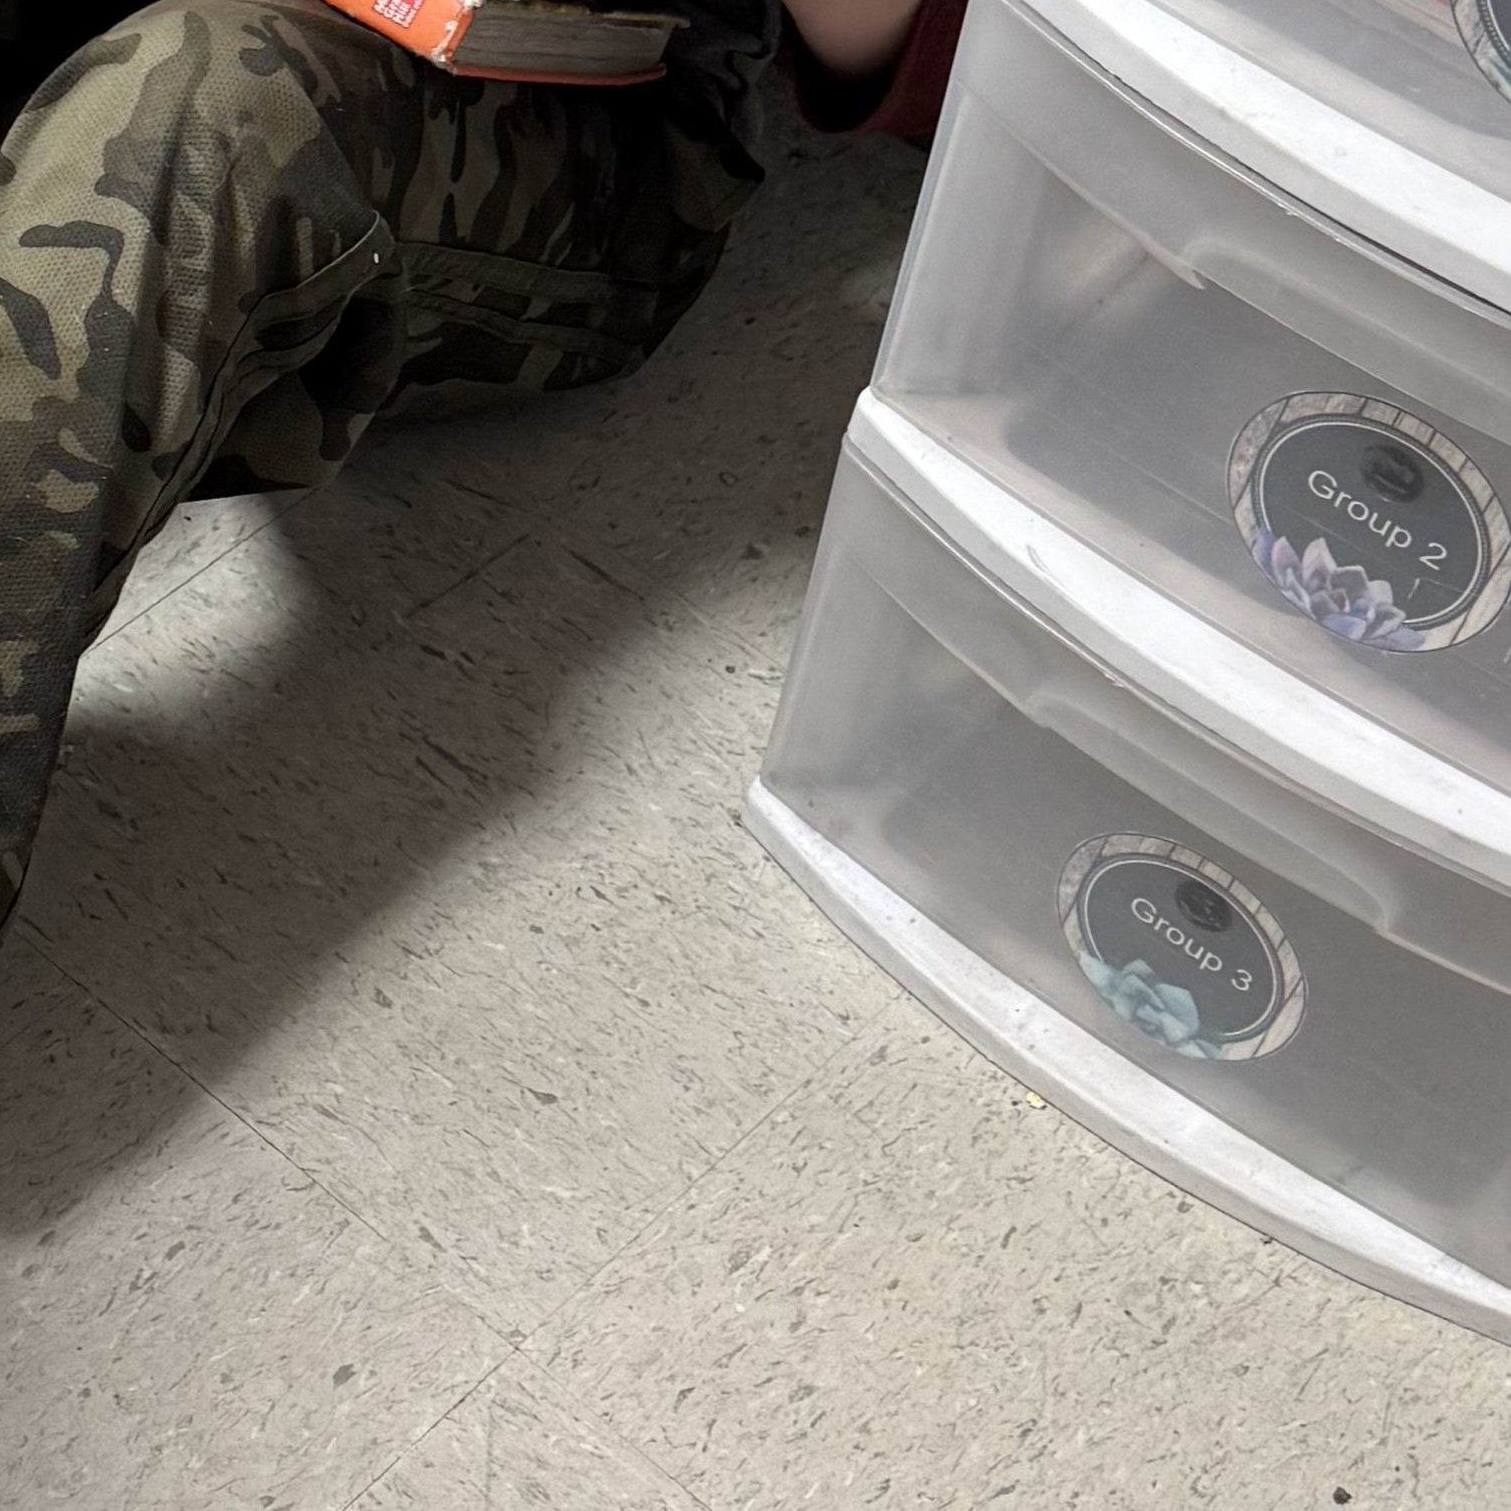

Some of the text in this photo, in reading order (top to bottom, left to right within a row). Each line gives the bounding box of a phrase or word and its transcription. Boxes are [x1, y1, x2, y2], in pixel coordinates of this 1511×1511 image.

[1307, 469, 1449, 571] Group 2
[1130, 897, 1254, 992] Group 3
